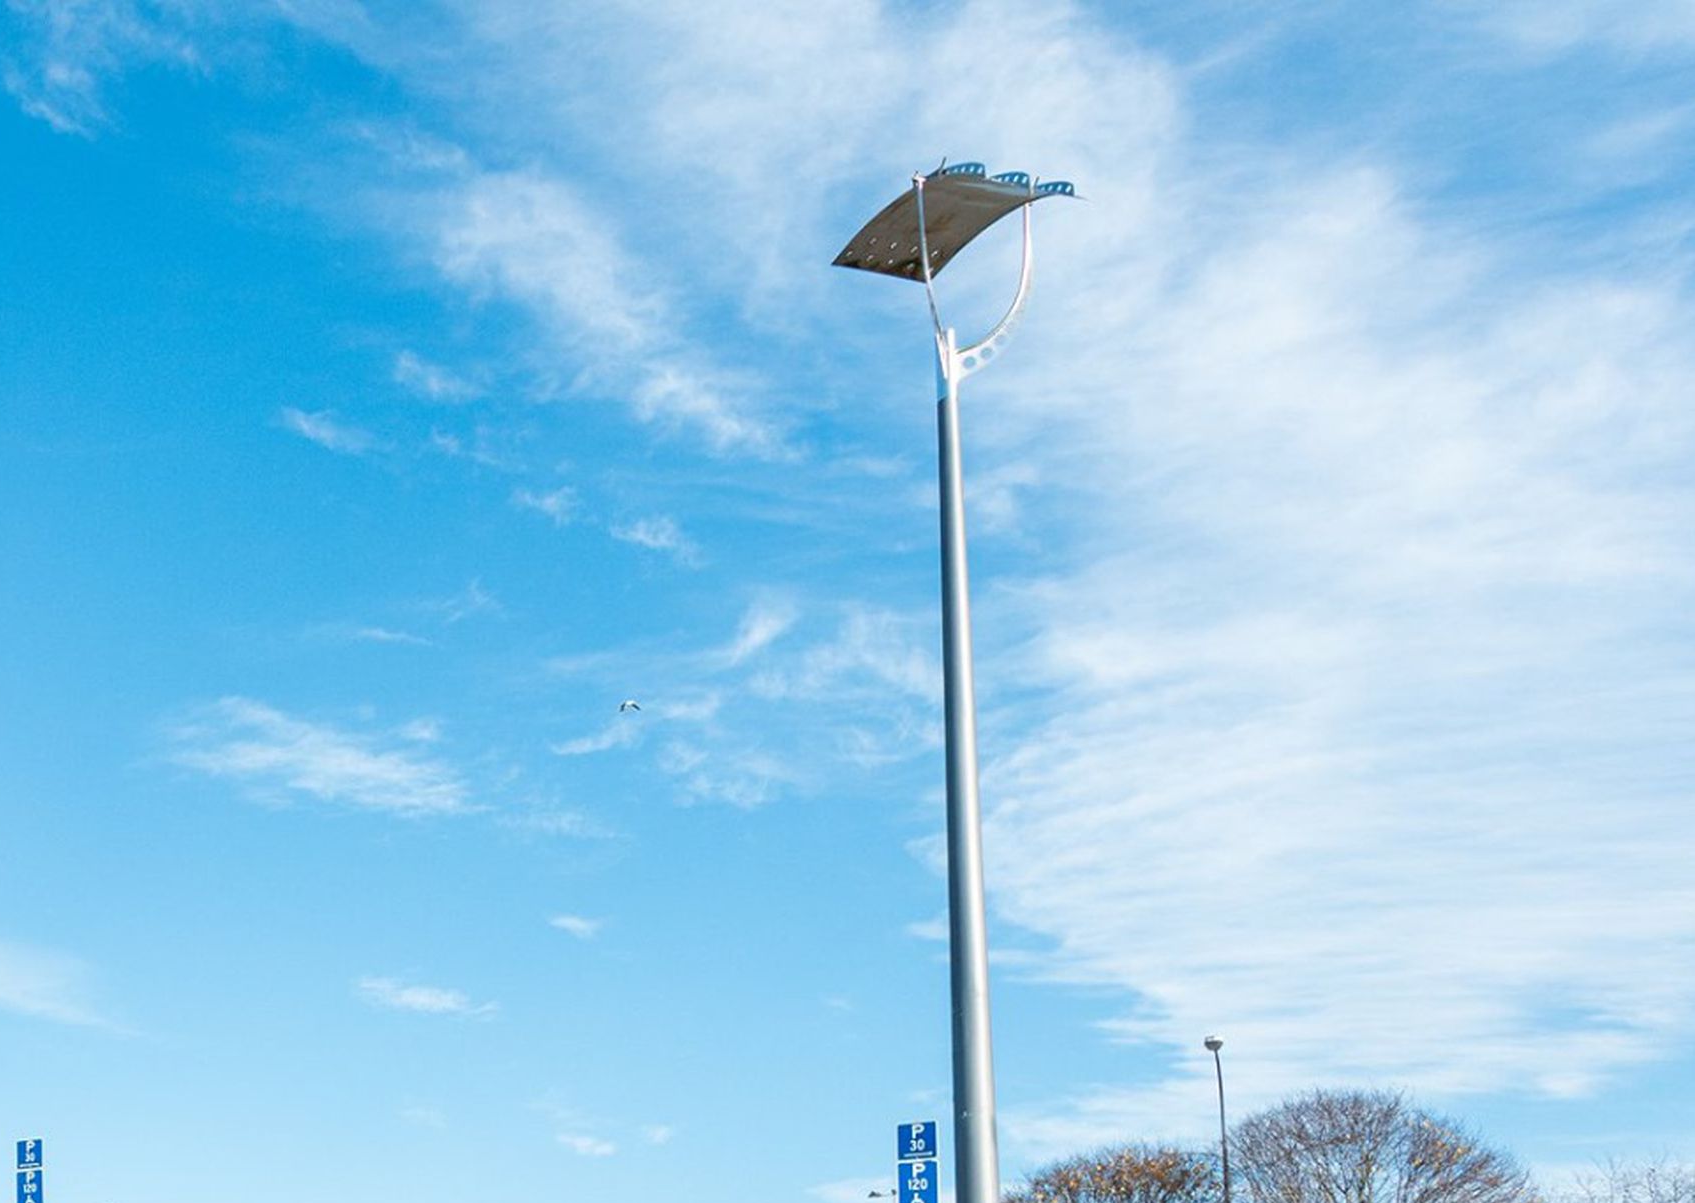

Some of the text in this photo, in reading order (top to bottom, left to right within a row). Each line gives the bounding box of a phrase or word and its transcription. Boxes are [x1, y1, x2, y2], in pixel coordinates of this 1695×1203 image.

[911, 1124, 924, 1139] P
[26, 1140, 35, 1153] P
[910, 1139, 925, 1151] 30
[912, 1163, 926, 1178] P
[26, 1171, 35, 1183] P
[908, 1178, 928, 1190] 120
